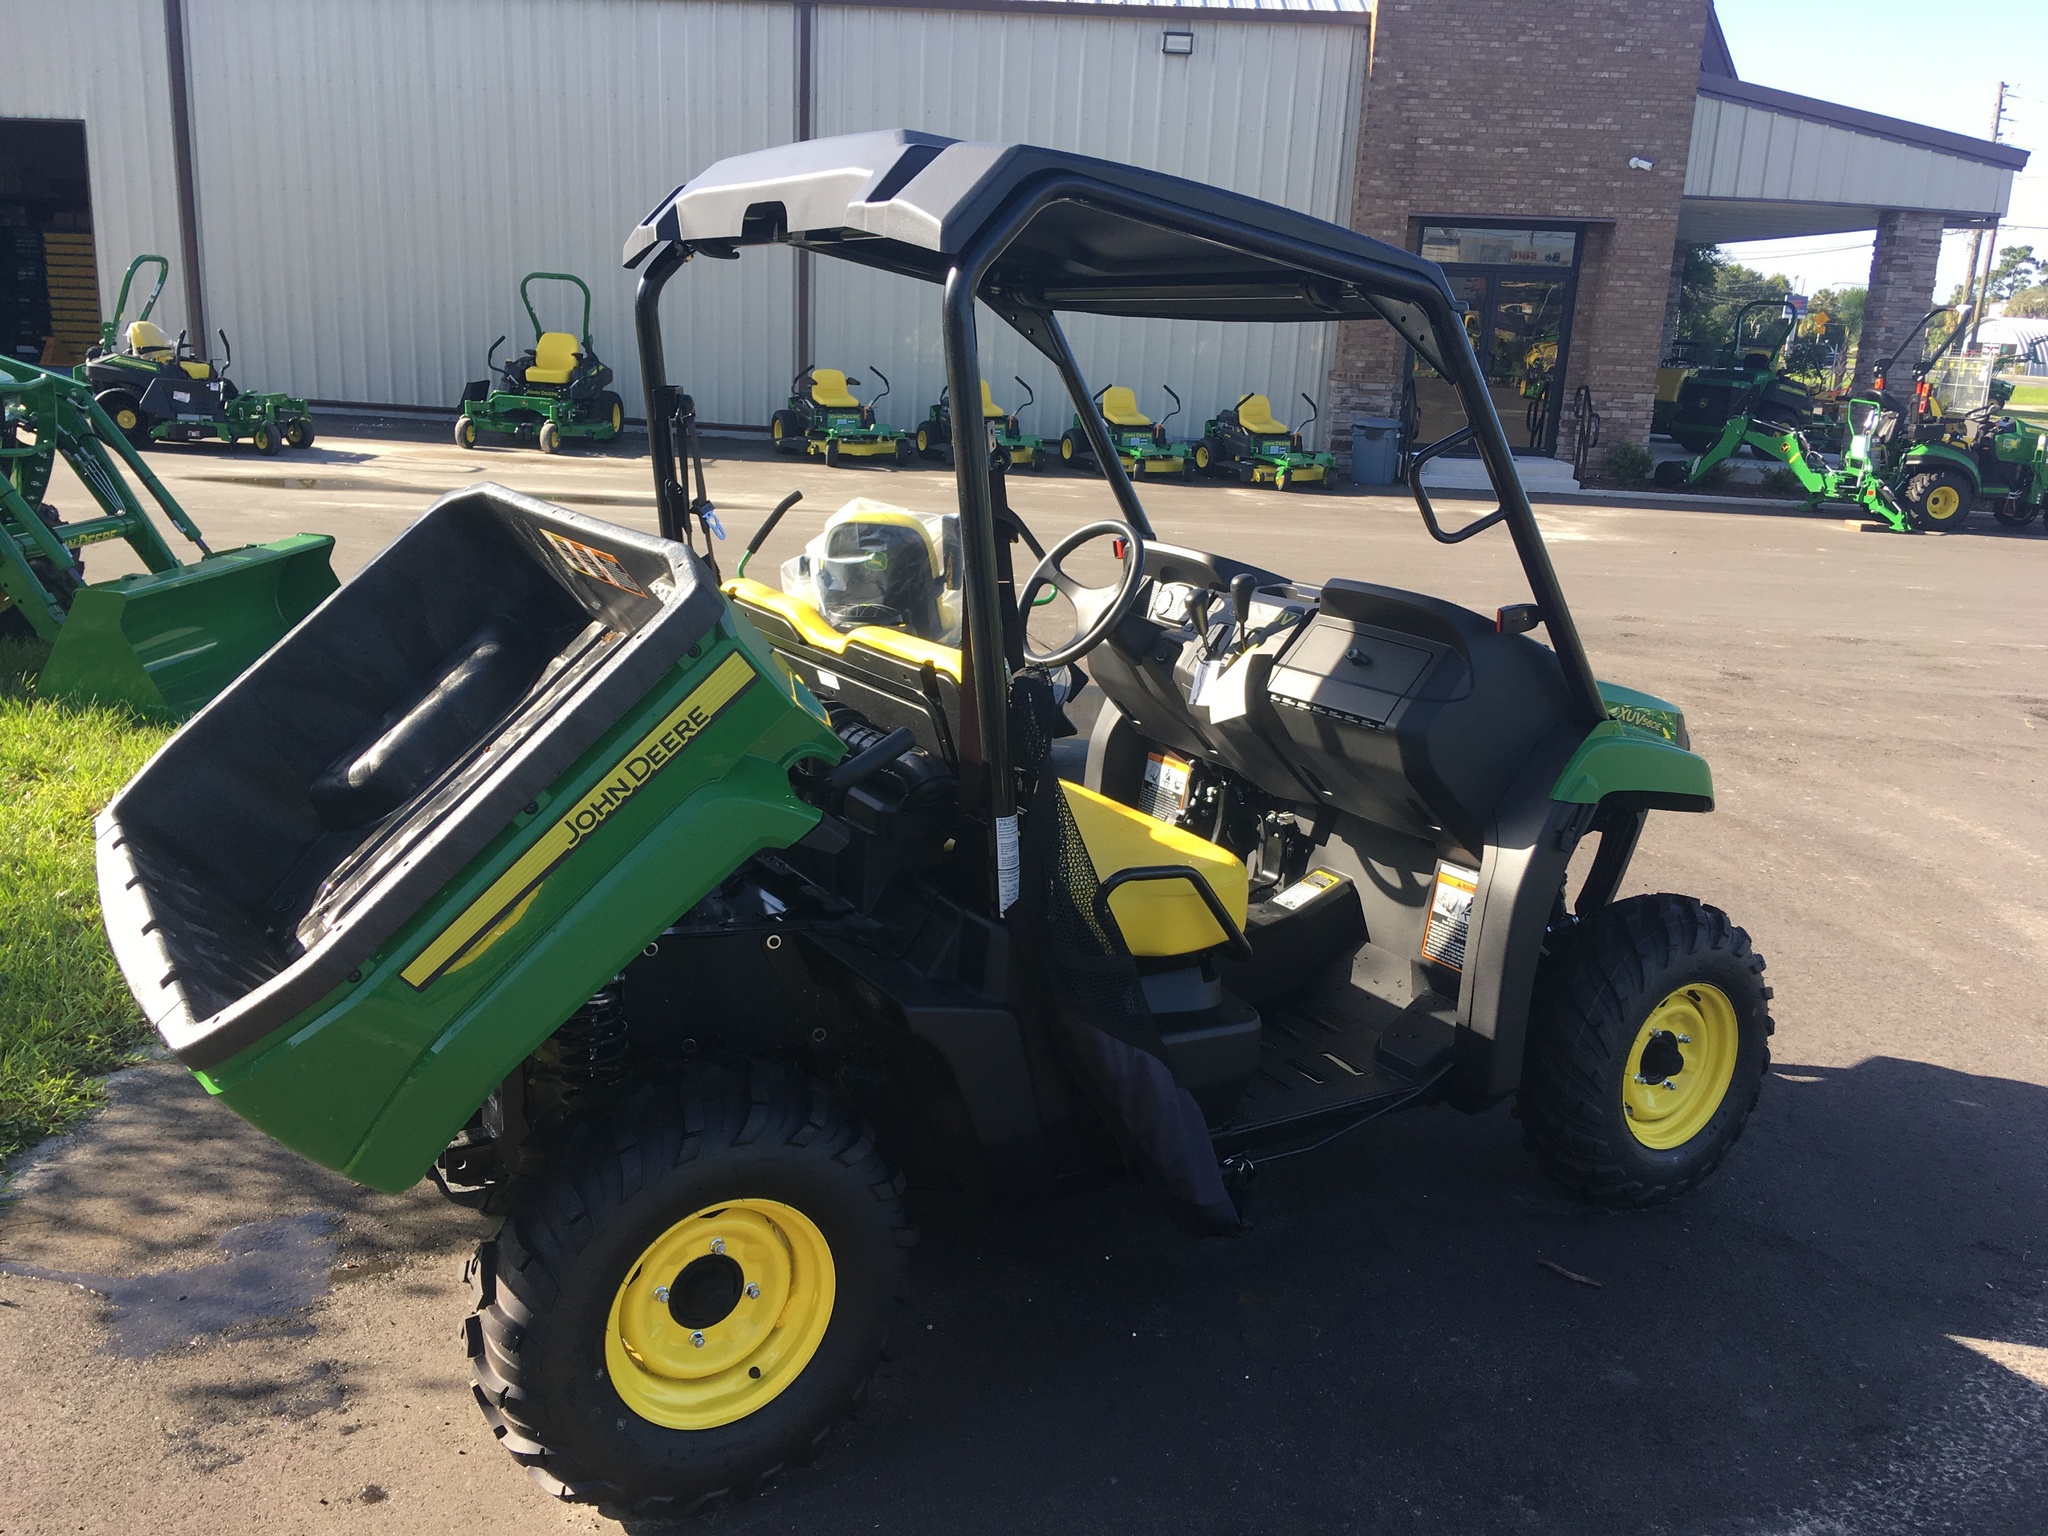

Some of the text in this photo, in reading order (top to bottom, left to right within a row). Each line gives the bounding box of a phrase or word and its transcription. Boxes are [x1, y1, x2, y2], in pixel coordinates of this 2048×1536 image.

[79, 529, 117, 547] DEERE
[1618, 706, 1662, 731] XUV560E
[564, 705, 710, 845] JOHN DEERE
